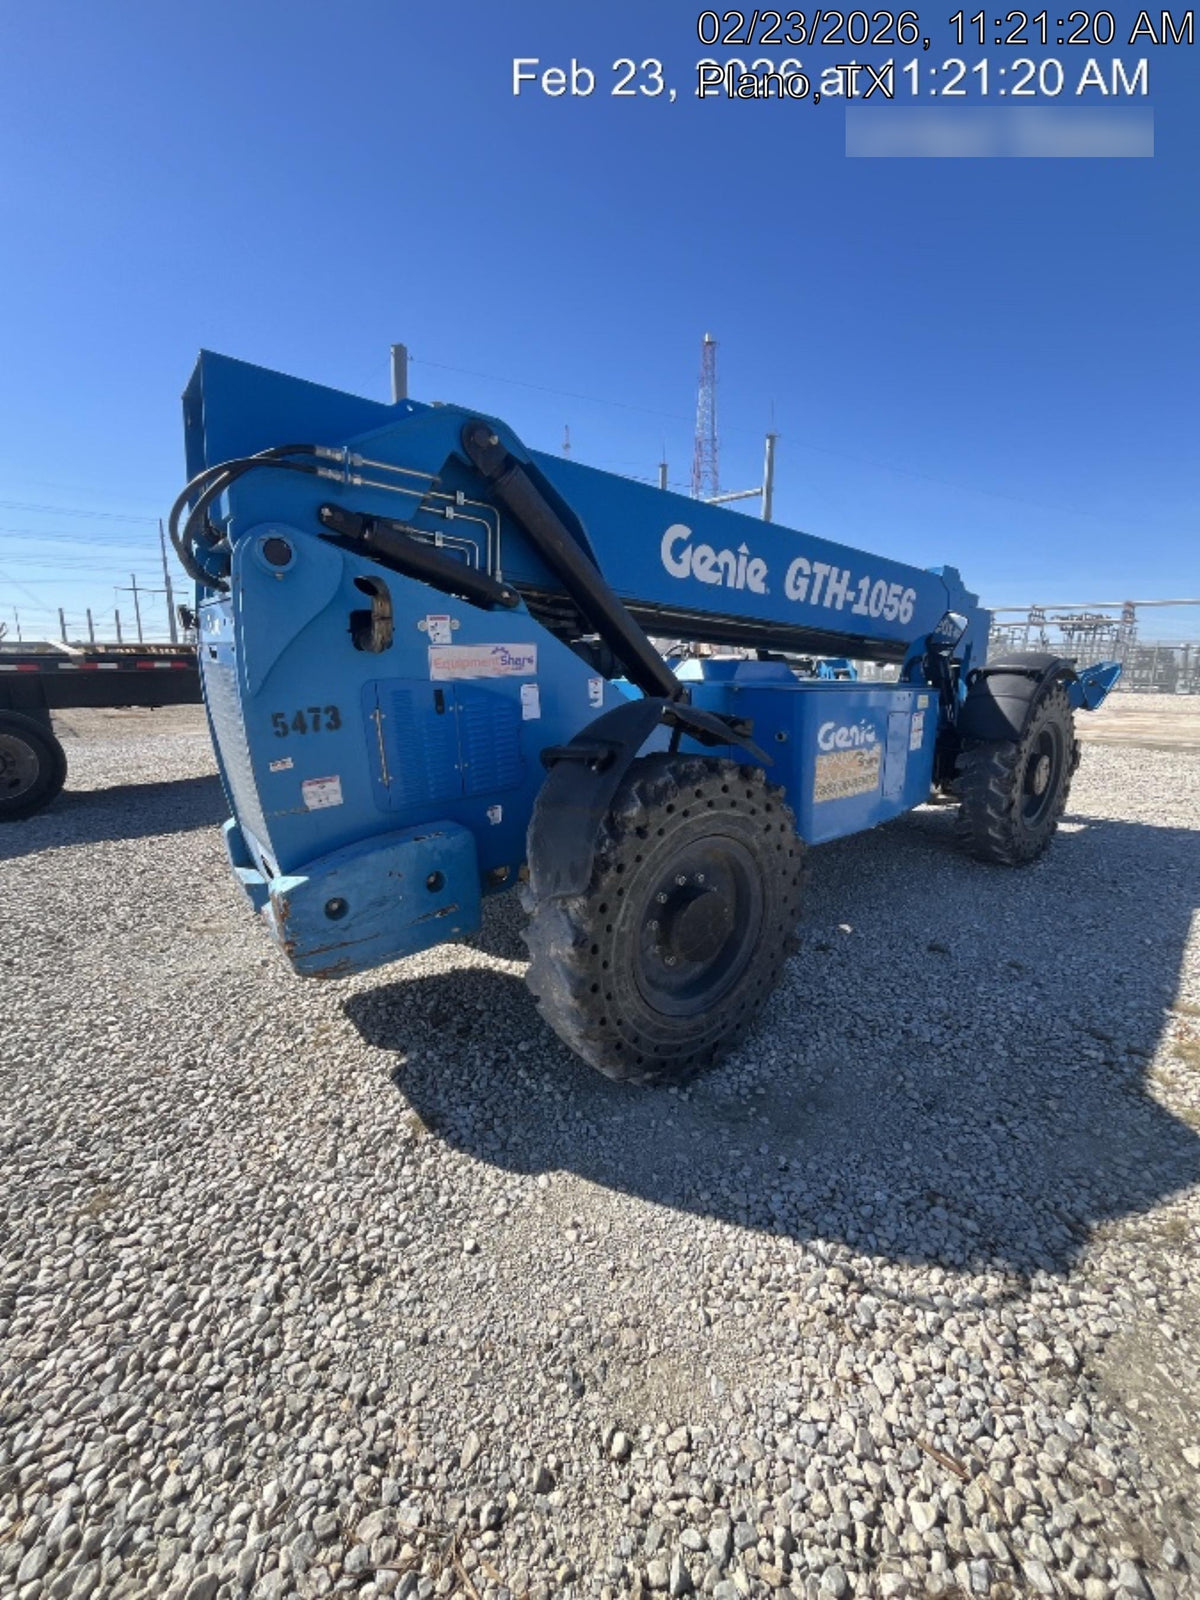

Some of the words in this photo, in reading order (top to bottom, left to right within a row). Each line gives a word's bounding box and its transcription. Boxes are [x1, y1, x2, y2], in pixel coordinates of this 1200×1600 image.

[661, 524, 769, 594] Genie
[785, 557, 918, 625] GTH-1056
[272, 705, 342, 738] 5473
